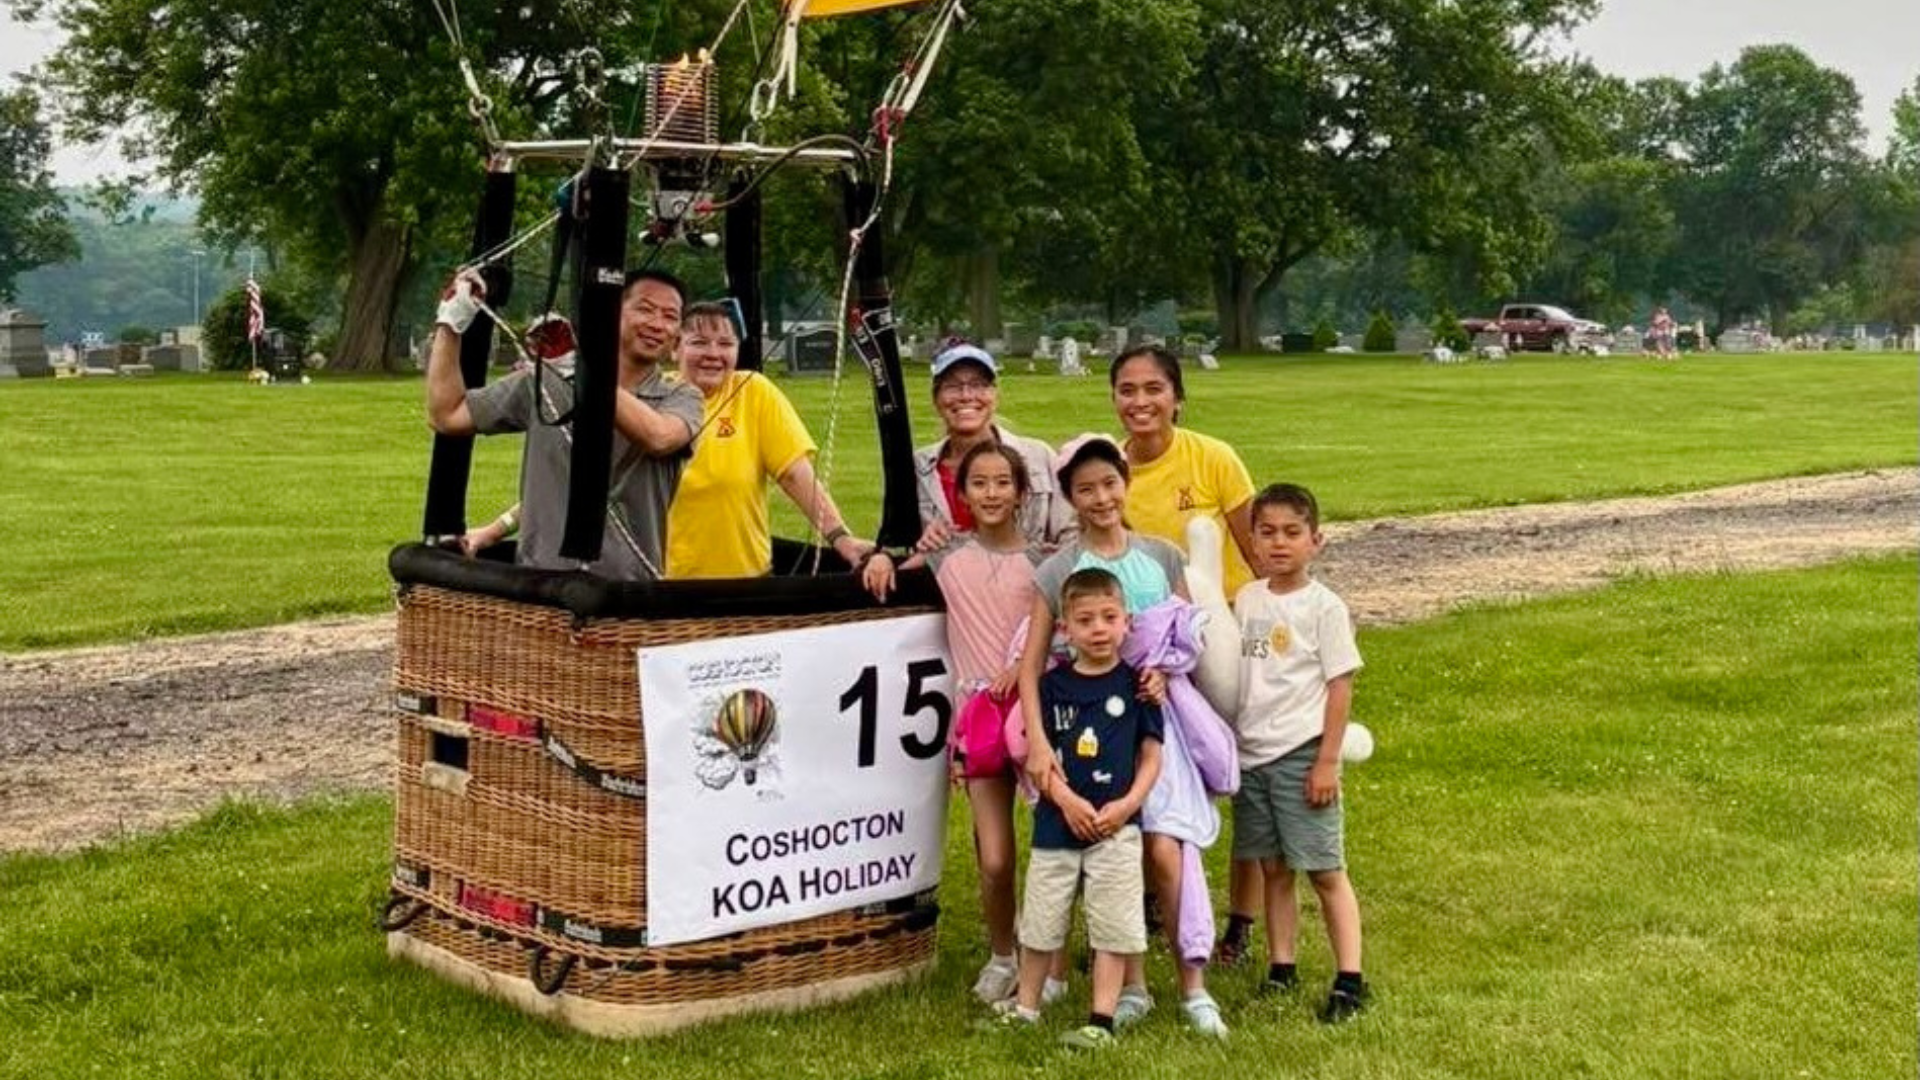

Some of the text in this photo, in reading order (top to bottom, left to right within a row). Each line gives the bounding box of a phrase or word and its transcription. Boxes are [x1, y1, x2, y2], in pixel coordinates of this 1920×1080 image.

[839, 658, 951, 768] 15
[725, 809, 905, 866] COSHOCTON
[712, 852, 916, 918] KOA HOLIDAY
